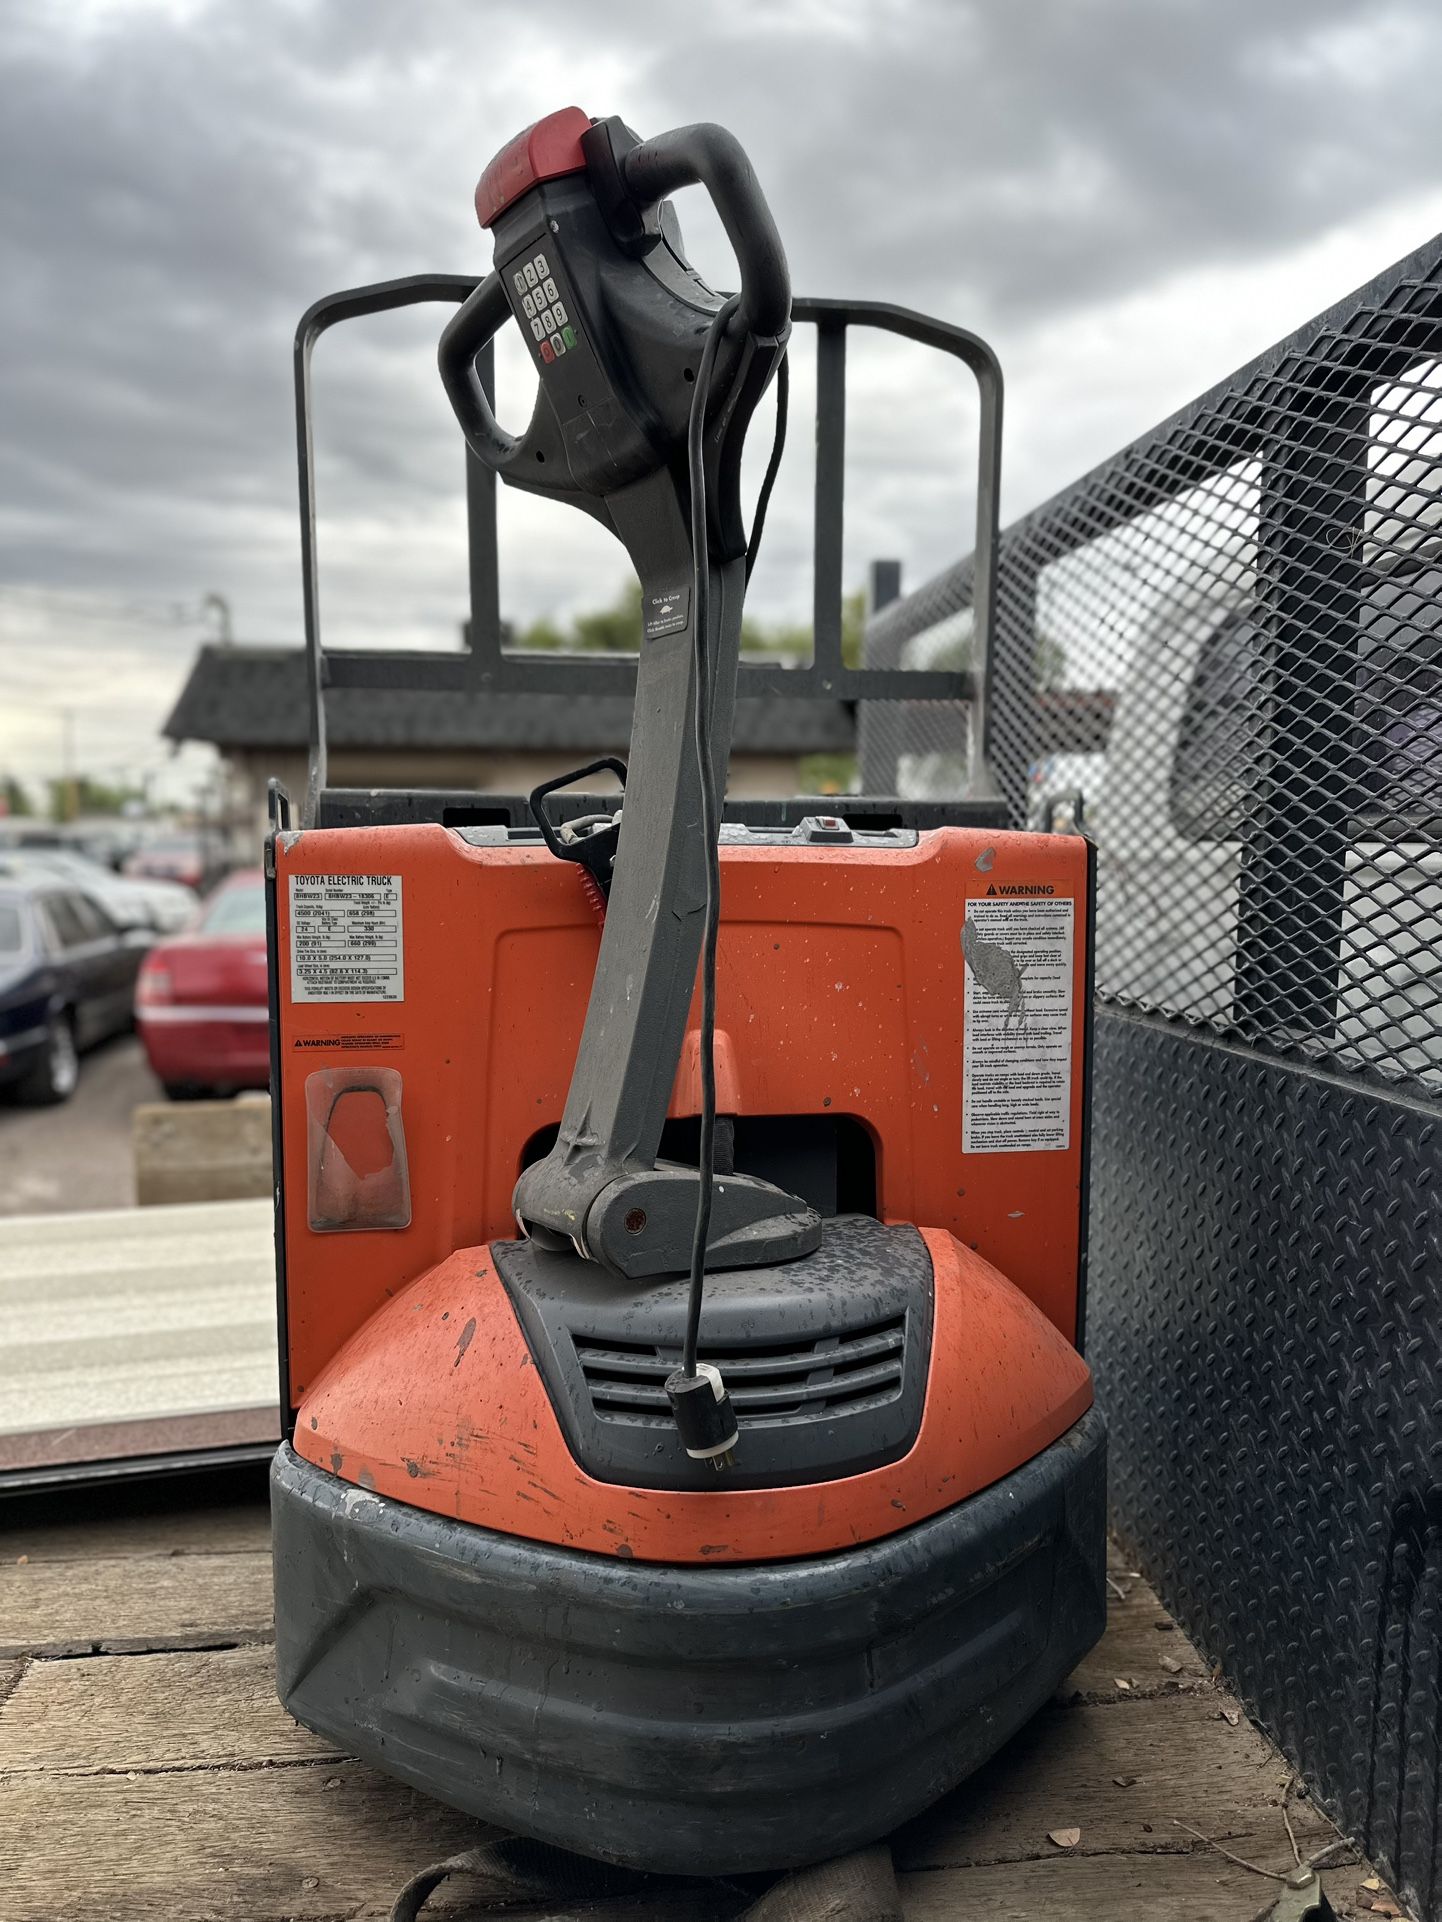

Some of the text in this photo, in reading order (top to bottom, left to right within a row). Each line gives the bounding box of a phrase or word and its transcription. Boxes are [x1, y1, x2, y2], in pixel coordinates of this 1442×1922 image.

[295, 876, 392, 886] TOYOTA ELECTRIC TRUCK
[999, 886, 1055, 895] WARNING
